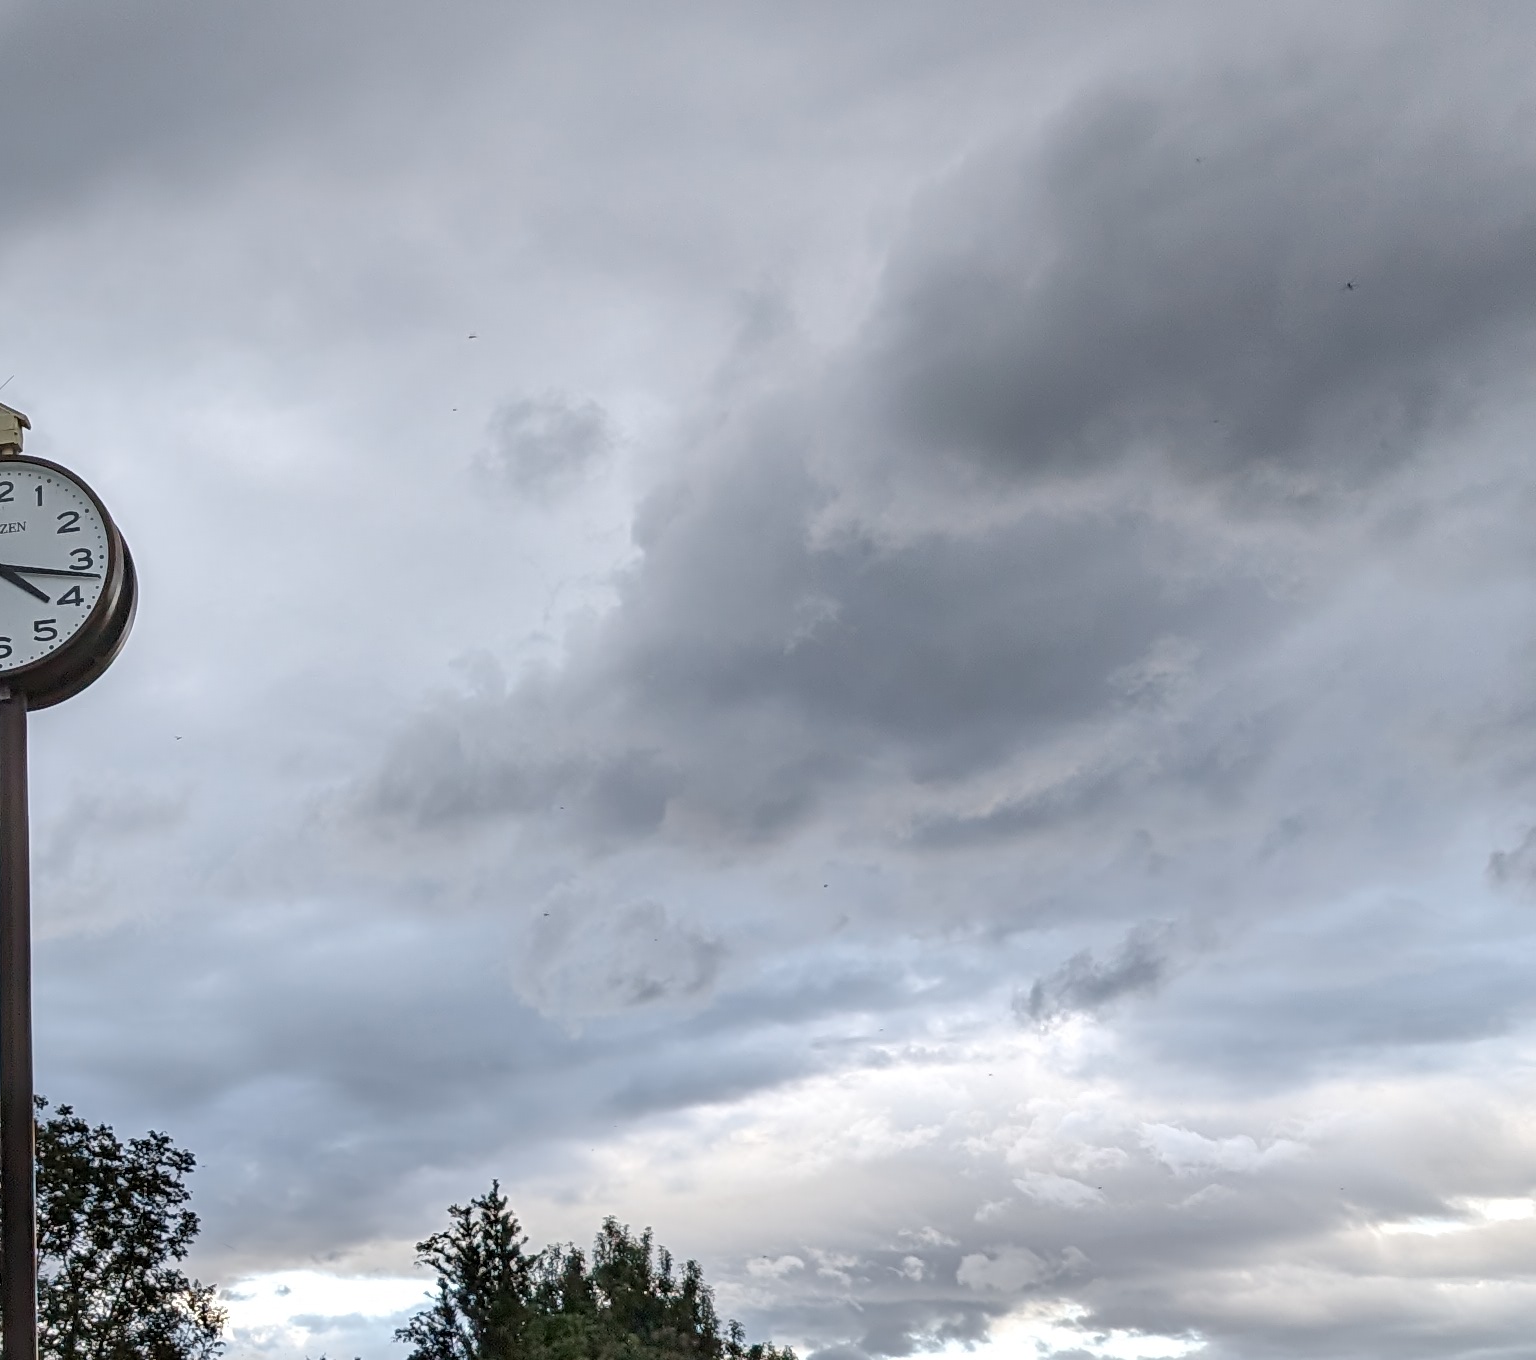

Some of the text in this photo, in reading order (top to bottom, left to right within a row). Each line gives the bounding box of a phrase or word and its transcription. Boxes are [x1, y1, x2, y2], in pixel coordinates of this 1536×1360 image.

[34, 485, 43, 507] 1
[56, 510, 81, 535] 2
[68, 547, 94, 571] 3
[56, 585, 85, 607] 4
[33, 618, 58, 642] 5
